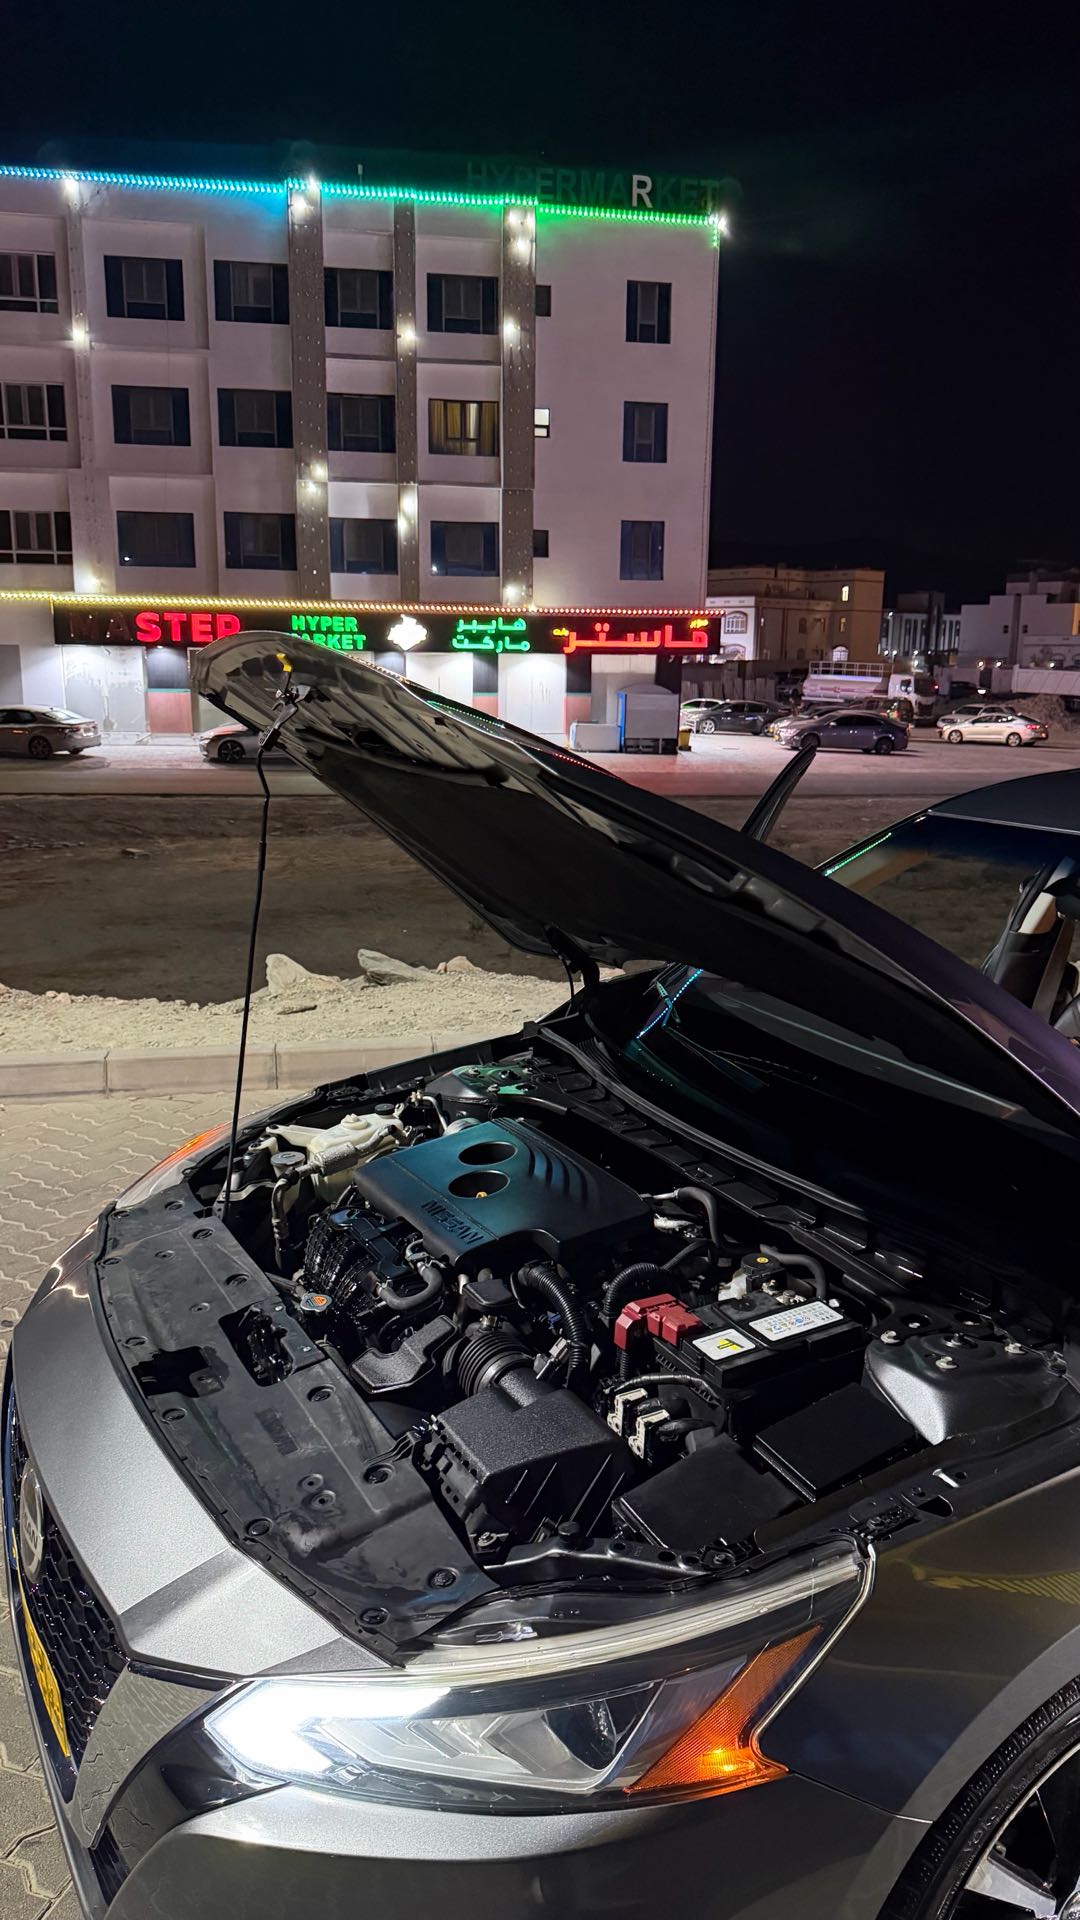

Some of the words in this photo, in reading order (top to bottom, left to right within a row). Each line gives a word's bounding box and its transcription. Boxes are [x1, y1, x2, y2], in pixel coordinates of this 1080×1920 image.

[291, 614, 359, 633] HYPER
[456, 616, 527, 634] هايبر
[451, 634, 531, 654] ماركت
[421, 1199, 485, 1245] NISSAN
